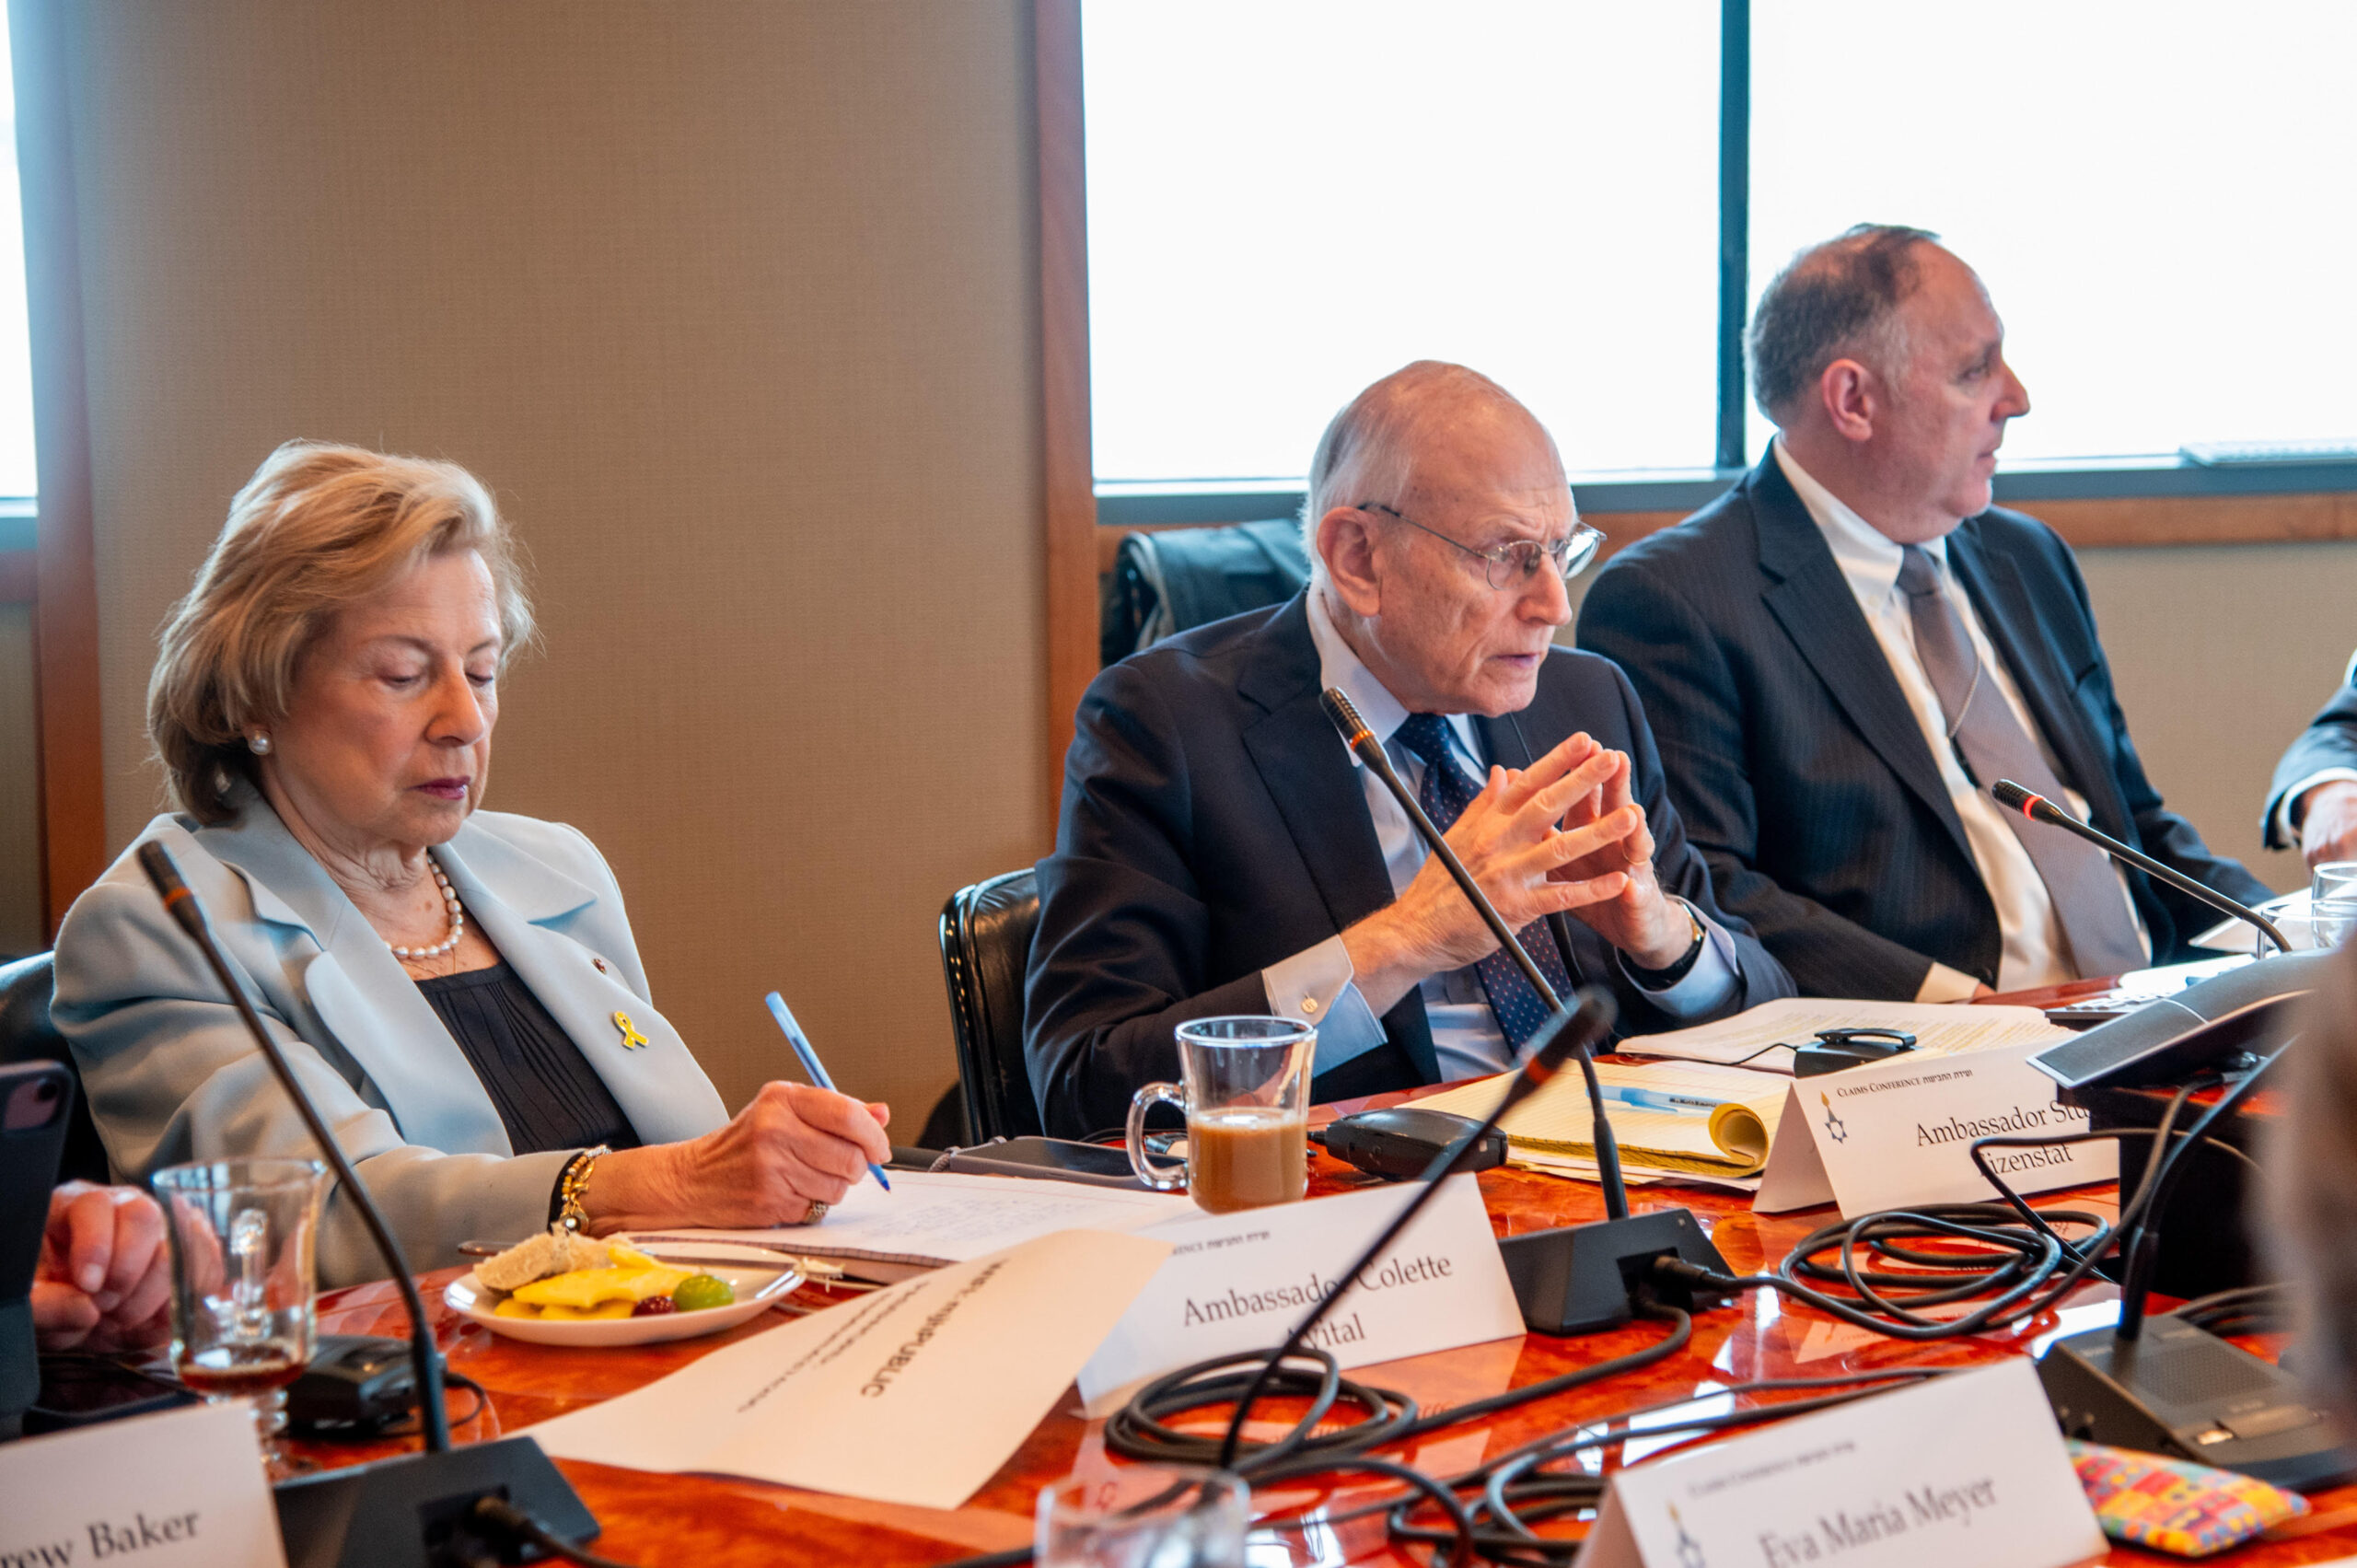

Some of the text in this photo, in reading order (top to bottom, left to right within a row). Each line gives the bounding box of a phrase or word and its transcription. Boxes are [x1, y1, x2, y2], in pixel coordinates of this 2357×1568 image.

[1916, 1106, 2048, 1147] Ambassador
[1978, 1143, 2073, 1178] izenstat
[1182, 1254, 1453, 1328] Ambassado Colette
[1284, 1312, 1366, 1352] vital
[87, 1512, 198, 1559] Baker
[1757, 1478, 1998, 1568] Eva Maria Meyer
